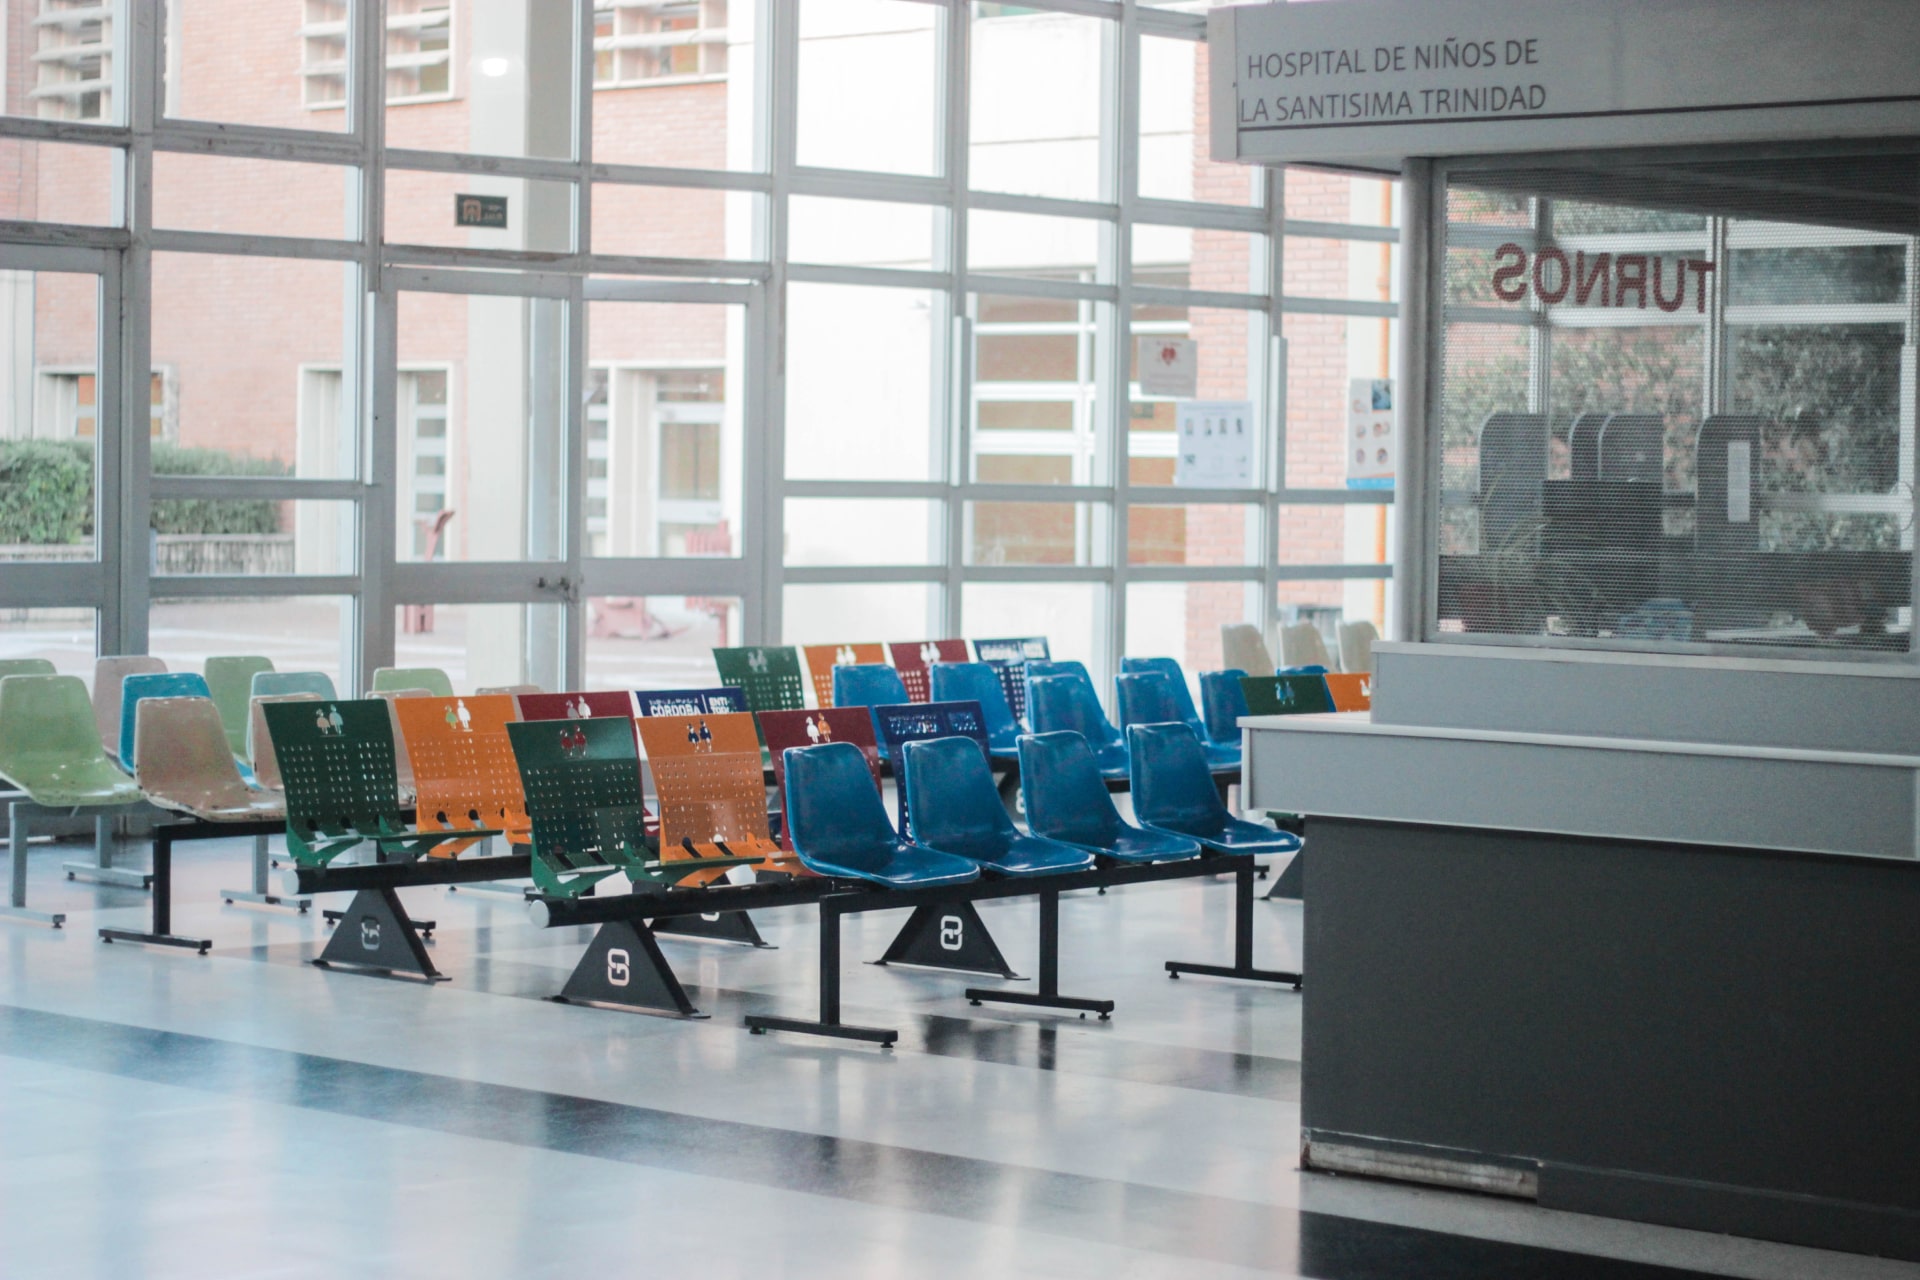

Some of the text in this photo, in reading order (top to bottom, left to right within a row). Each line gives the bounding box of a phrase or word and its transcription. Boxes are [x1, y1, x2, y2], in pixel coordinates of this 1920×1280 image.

[1248, 37, 1539, 79] HOSPITAL DE NIÑOS DE
[1240, 84, 1547, 123] LA SANTISIMA TRINIDAD
